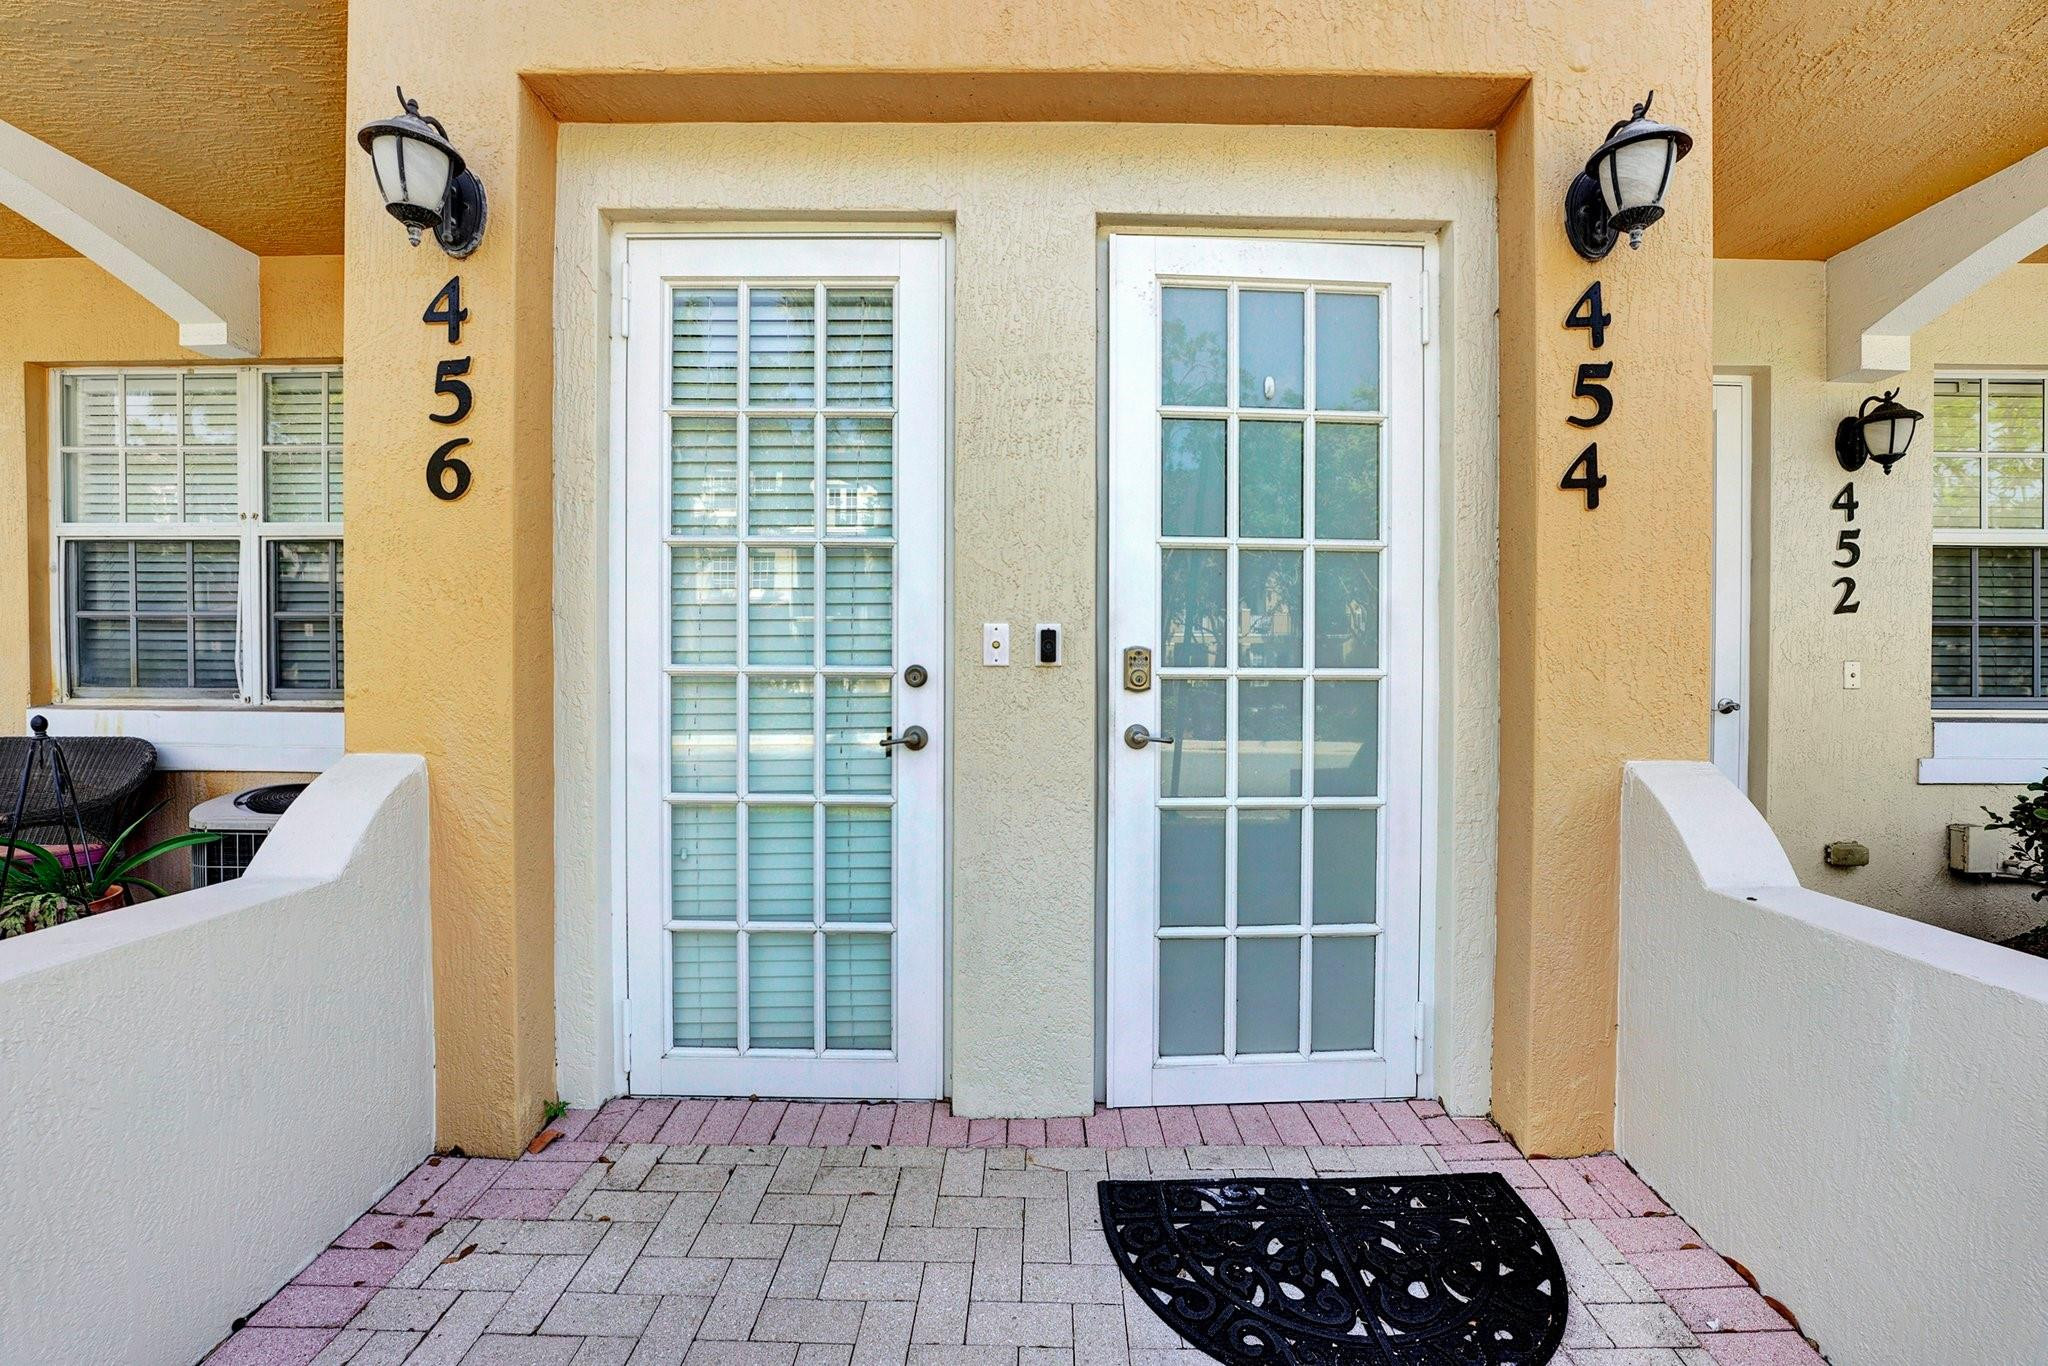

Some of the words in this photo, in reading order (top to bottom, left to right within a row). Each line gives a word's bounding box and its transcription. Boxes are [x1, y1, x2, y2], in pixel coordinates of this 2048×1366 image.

[422, 276, 473, 501] 456
[1560, 281, 1613, 511] 454
[1831, 482, 1861, 615] 452
